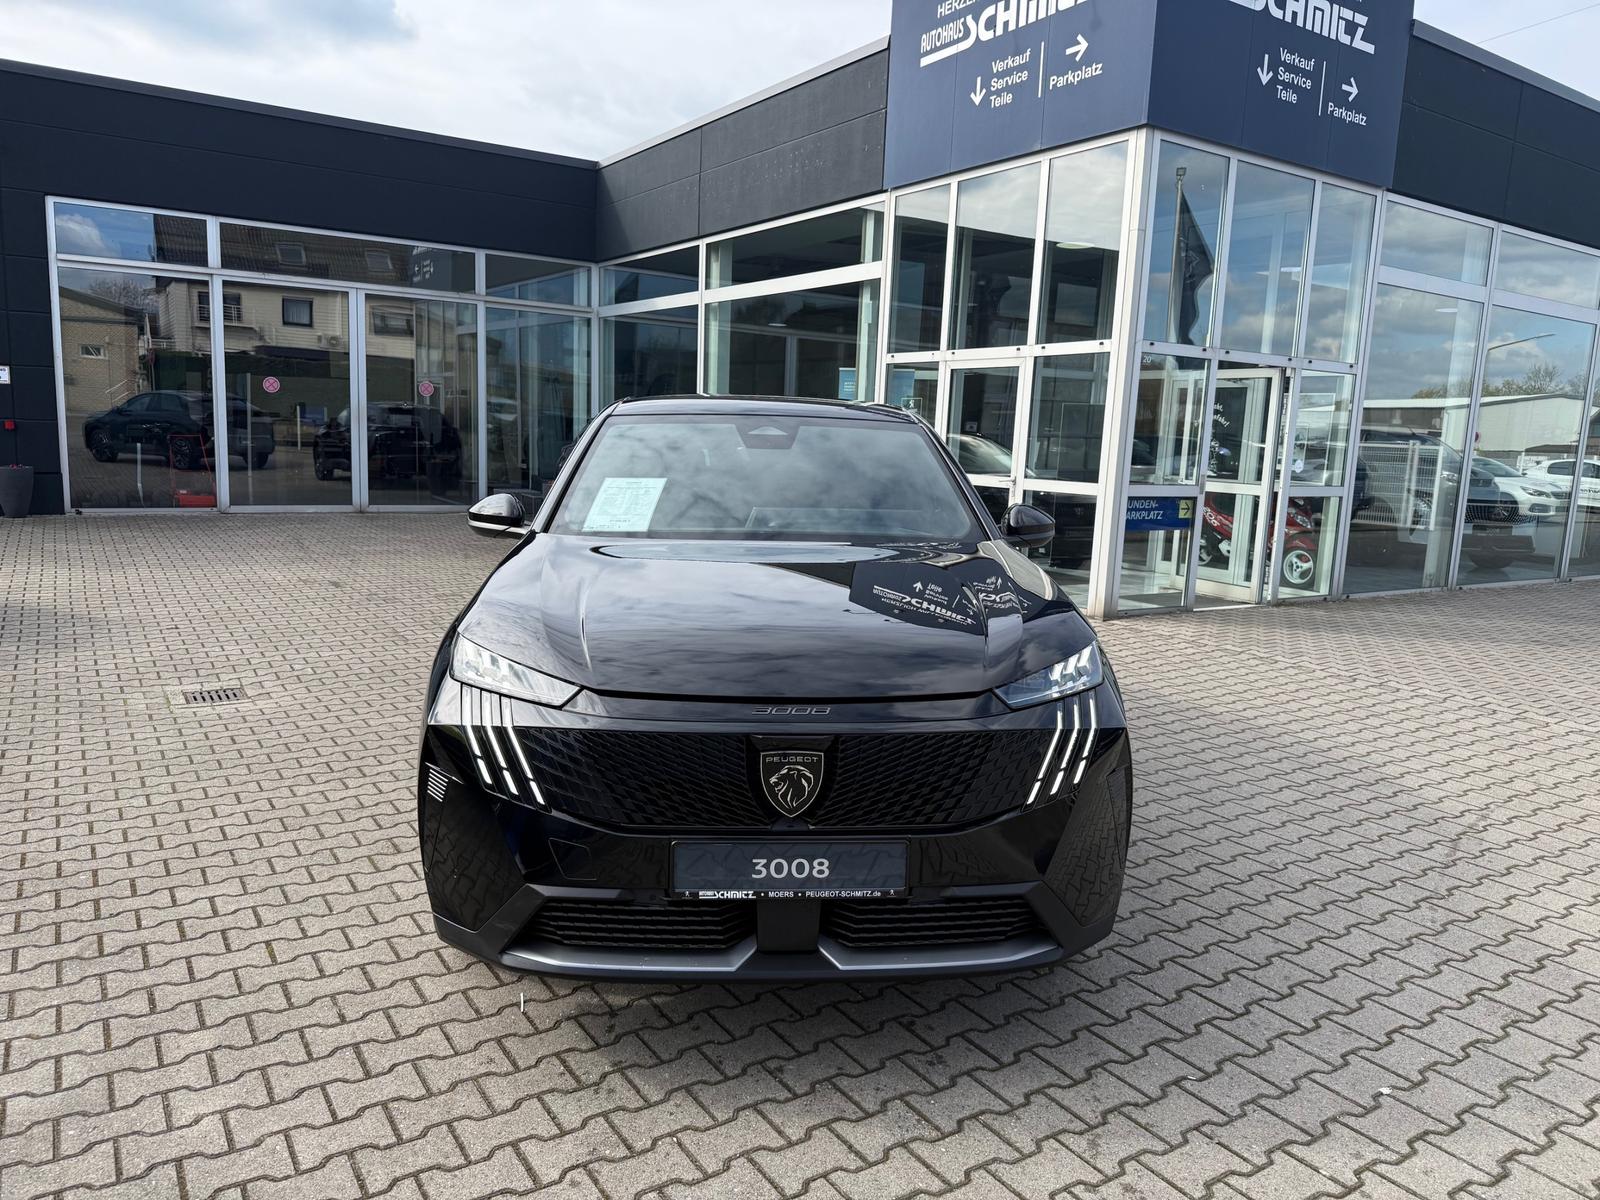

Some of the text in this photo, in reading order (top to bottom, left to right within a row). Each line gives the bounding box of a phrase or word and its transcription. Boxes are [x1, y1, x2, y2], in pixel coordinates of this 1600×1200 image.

[920, 17, 965, 54] AUTOHAUS
[991, 48, 1031, 74] Verkauf
[1279, 47, 1315, 72] Verkauf
[990, 69, 1029, 92] Service
[1049, 62, 1103, 91] Parkplatz
[1277, 66, 1312, 90] Service
[990, 91, 1013, 109] Teile
[1276, 85, 1298, 104] Teile
[1327, 102, 1367, 126] Parkplatz
[1126, 499, 1159, 509] UNDEN-
[1126, 510, 1164, 520] ARKPLATZ
[752, 706, 831, 715] 3008
[751, 858, 830, 879] 3008
[805, 890, 881, 898] PEUGEOT-SCHMITZ.de
